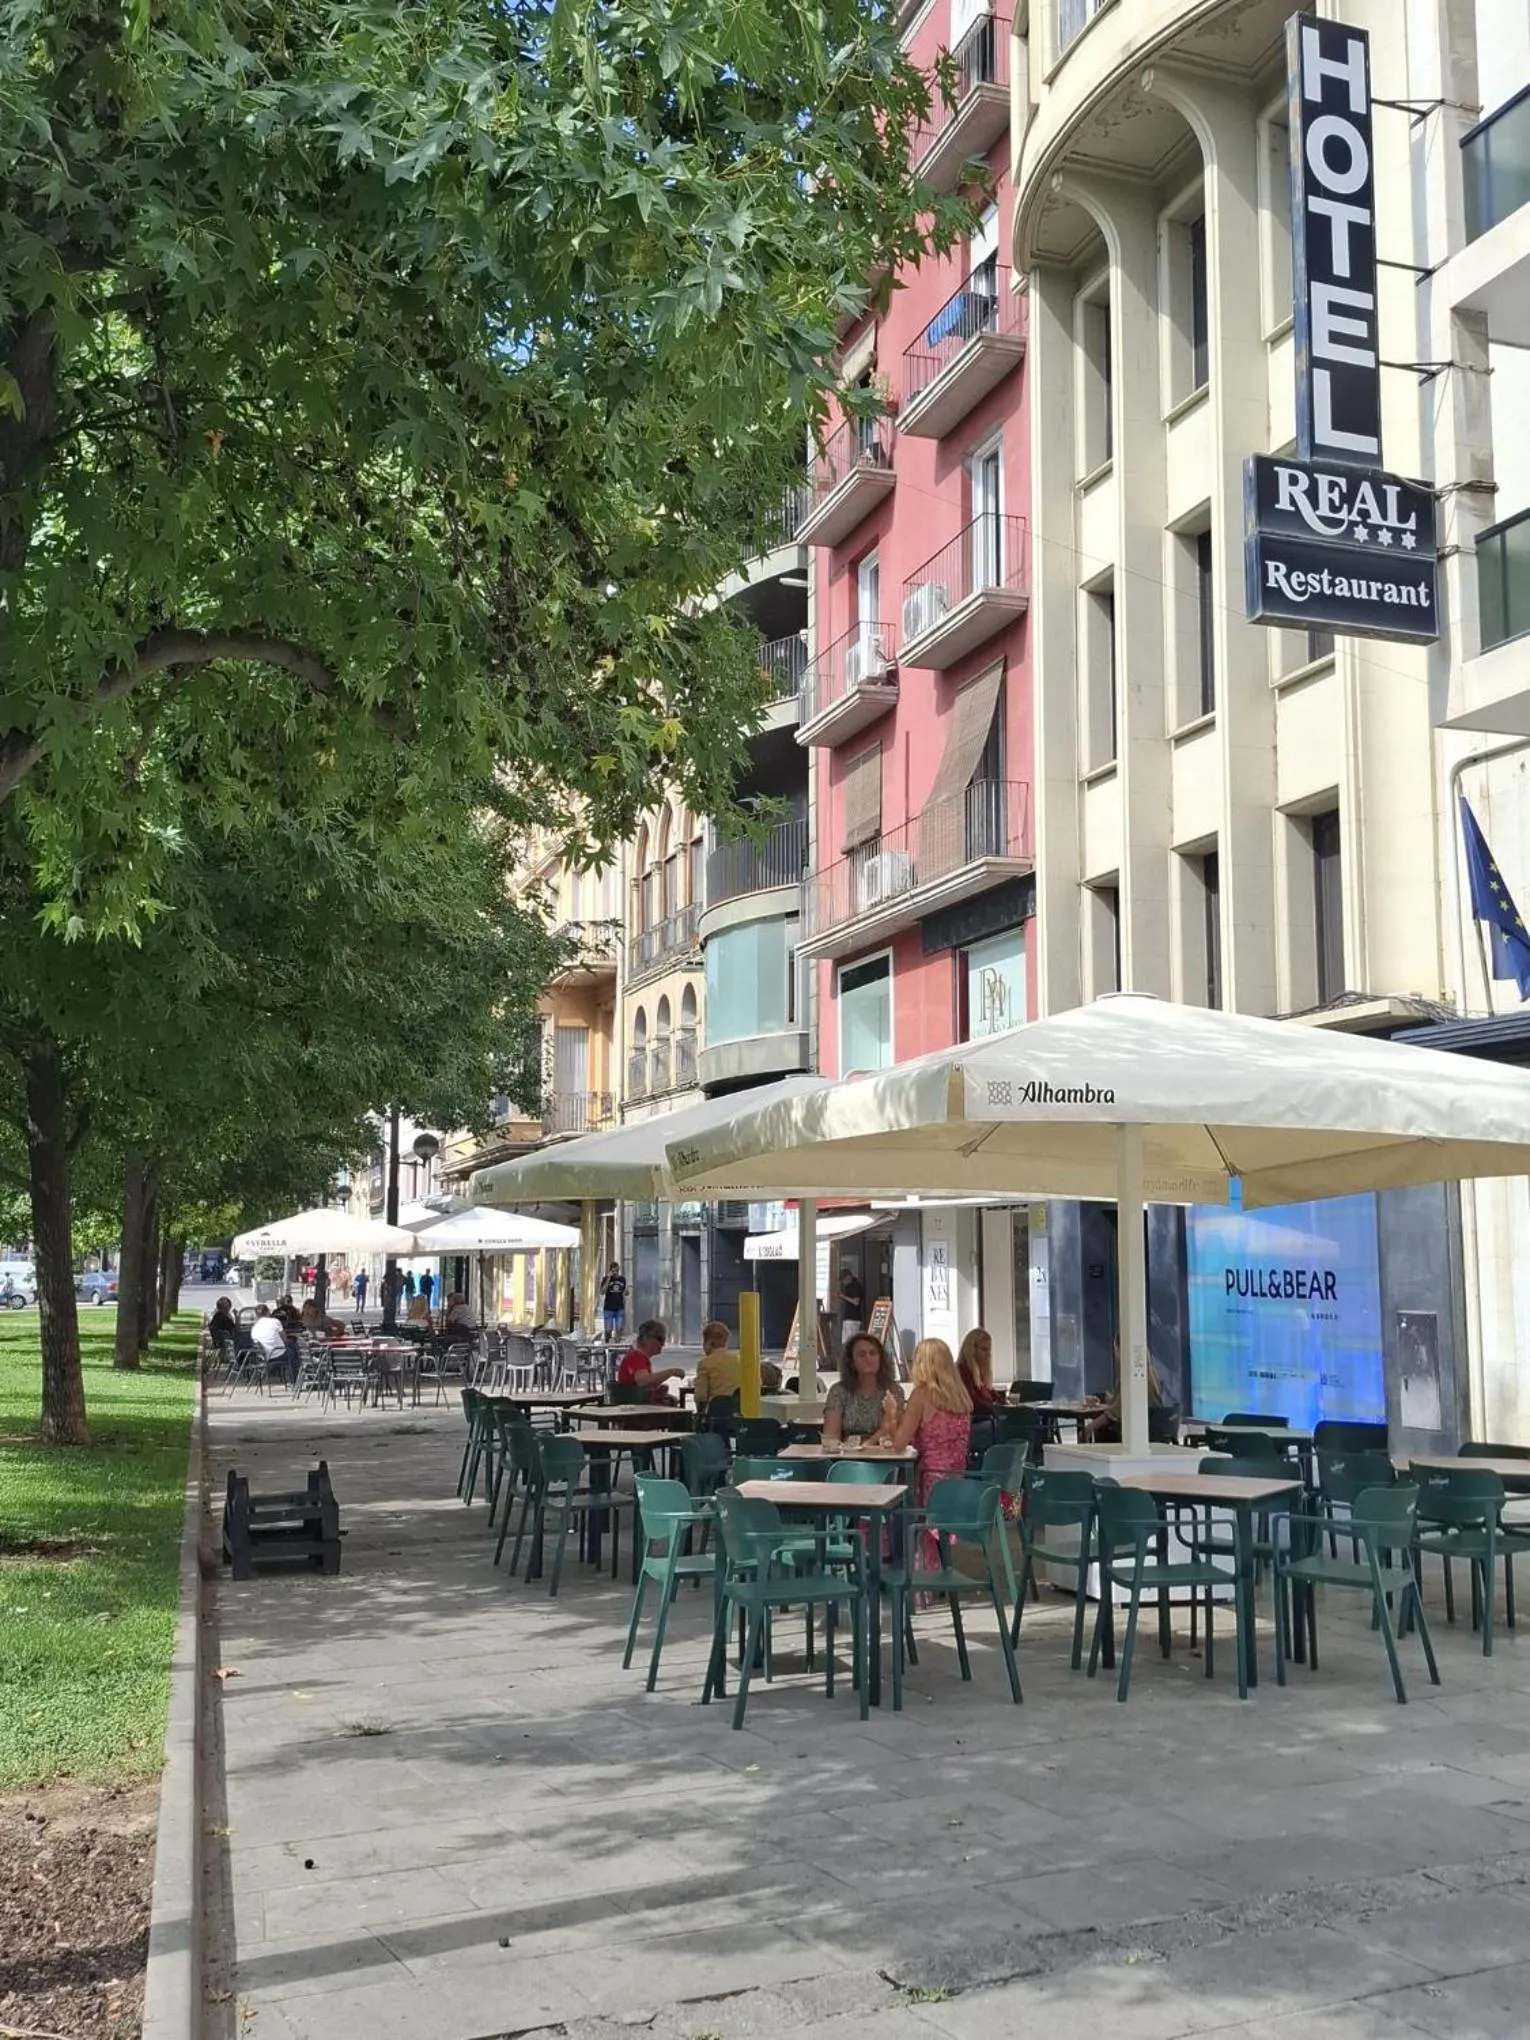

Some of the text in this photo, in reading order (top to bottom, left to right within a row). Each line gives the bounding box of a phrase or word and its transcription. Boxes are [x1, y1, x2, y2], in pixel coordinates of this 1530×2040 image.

[1302, 26, 1379, 455] HOTEL
[1274, 466, 1417, 536] REAL
[1265, 560, 1431, 609] Restaurant
[1017, 1080, 1115, 1105] Alhambra
[1224, 1268, 1338, 1301] PULL&BEAR
